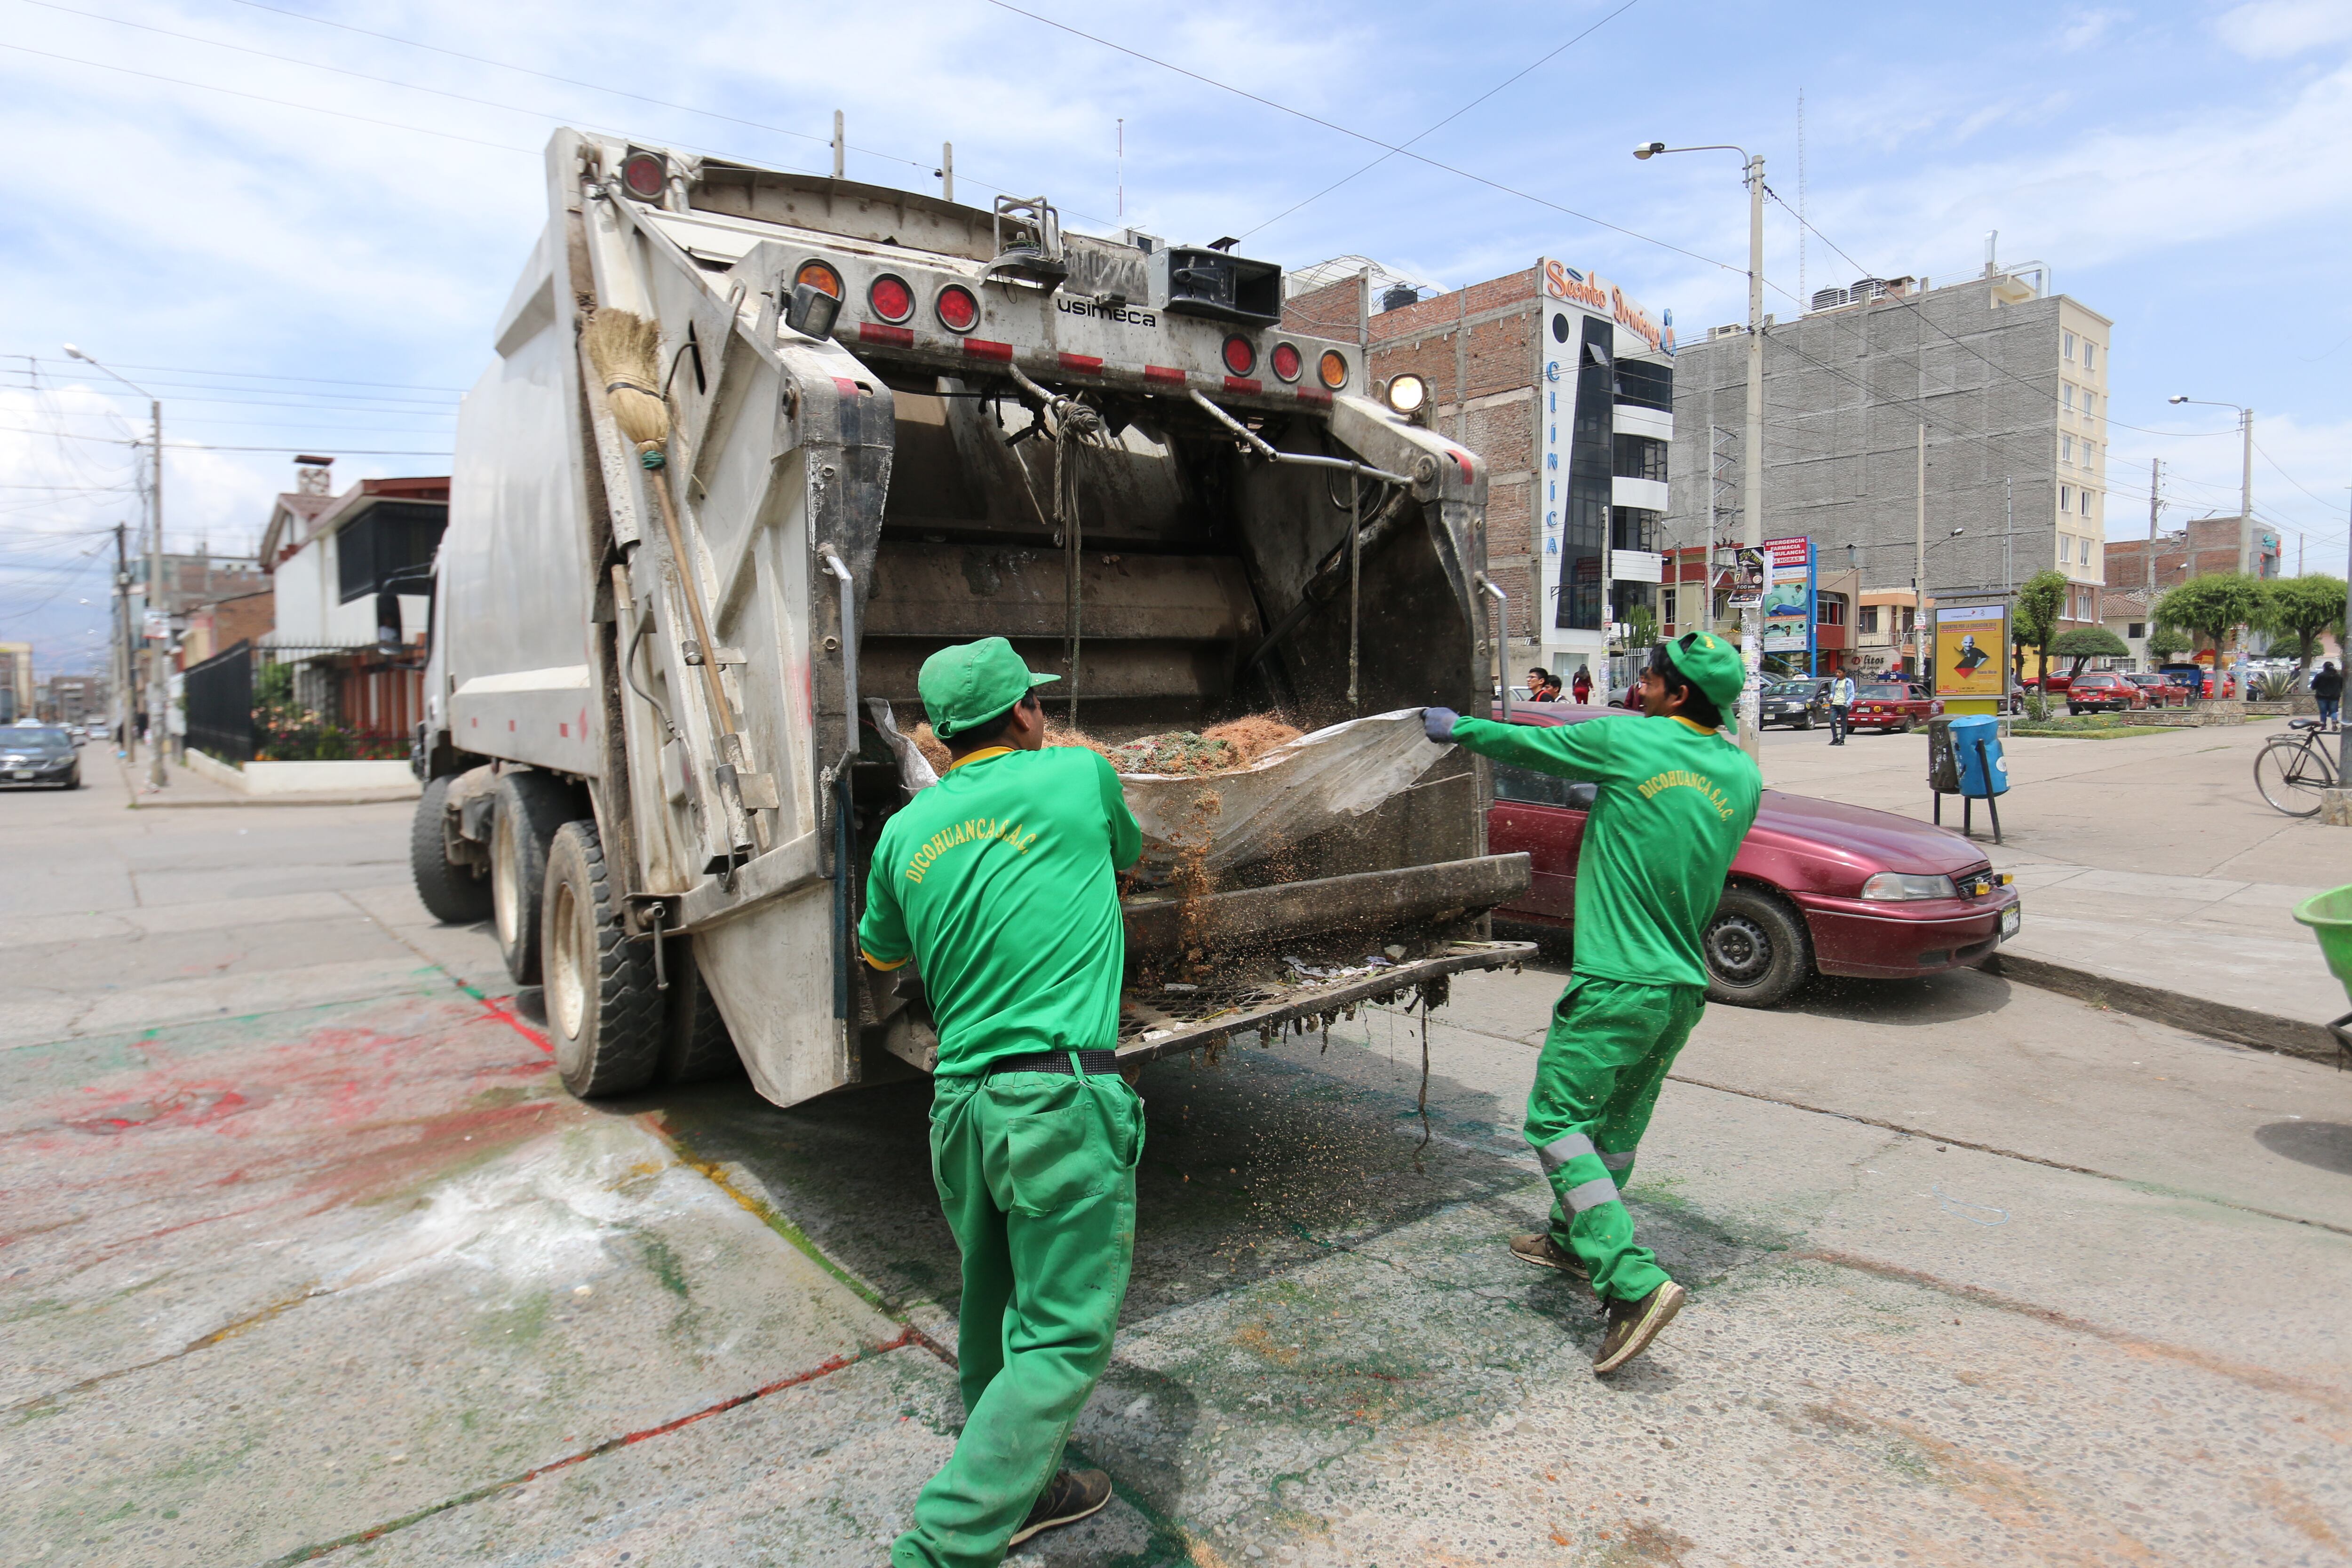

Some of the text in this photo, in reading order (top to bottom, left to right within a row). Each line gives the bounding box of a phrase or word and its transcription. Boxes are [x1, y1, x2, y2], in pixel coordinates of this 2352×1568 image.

[1057, 298, 1156, 327] usimeca
[1546, 260, 1661, 353] Santo Domingo
[1637, 770, 1734, 821] DICOHUANCA S.A.C.
[906, 818, 1037, 884] DICOHUANCA S.A.C.
